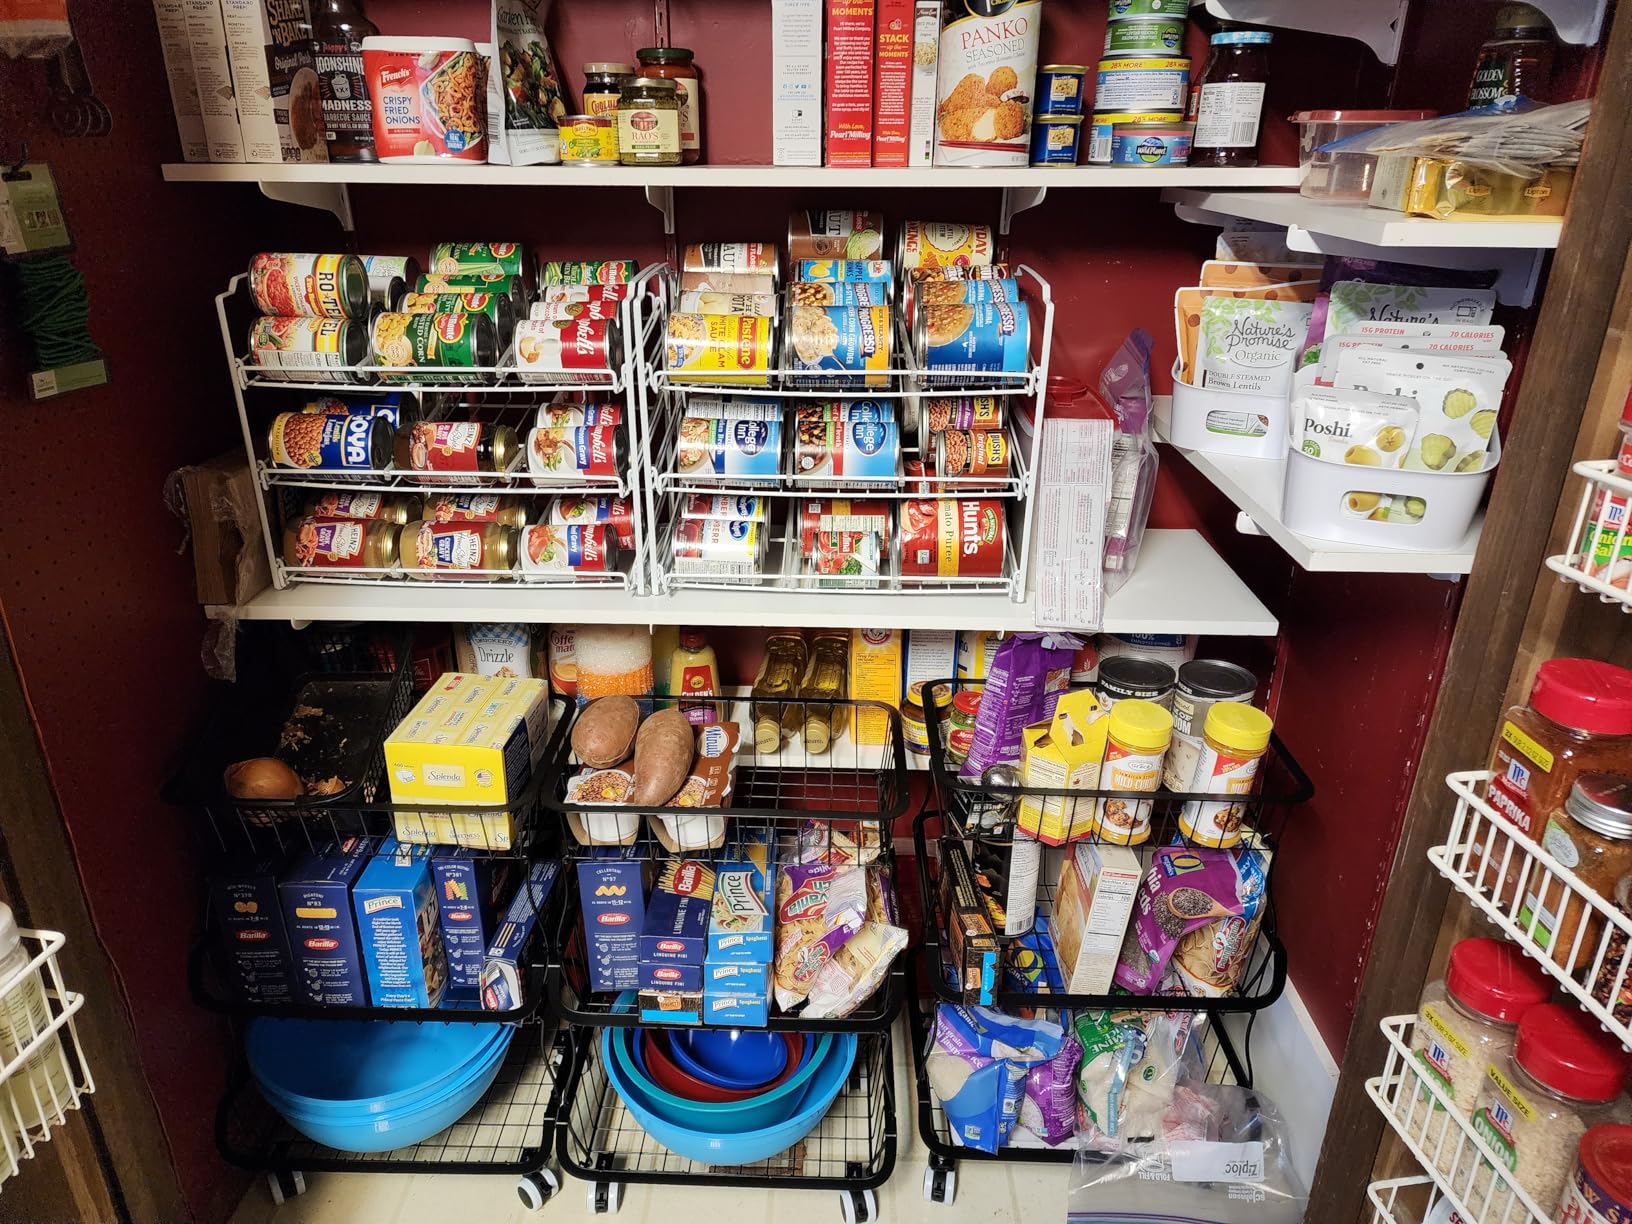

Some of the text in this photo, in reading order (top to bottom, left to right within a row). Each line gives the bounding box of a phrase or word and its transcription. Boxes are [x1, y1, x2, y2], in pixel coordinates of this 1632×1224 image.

[268, 0, 305, 26] SHAKE
[831, 7, 874, 16] MOMENTS
[879, 34, 909, 43] STACK
[960, 17, 1028, 50] PANKO
[965, 38, 1025, 63] SEASONED
[381, 67, 410, 83] French's
[1476, 69, 1504, 82] GOLDEN
[321, 100, 372, 111] MADNESS
[383, 96, 412, 105] CRISPY
[351, 113, 372, 121] SAUCE
[384, 106, 409, 115] FRIED
[385, 116, 421, 125] ONIONS
[632, 131, 659, 140] RAO'S
[857, 306, 875, 354] PROGRESSO
[1230, 316, 1296, 339] Nature's
[1374, 327, 1405, 336] PROTEIN
[1460, 331, 1495, 340] CALORIES
[709, 320, 719, 353] SAUCE
[740, 316, 756, 366] Pastene
[1225, 334, 1297, 353] Promise
[416, 336, 427, 364] CORN
[717, 340, 727, 368] CLAM
[1235, 350, 1281, 362] Organic
[1439, 343, 1475, 352] CALORIES
[1208, 370, 1271, 382] DOUBLE STEAMED
[1208, 377, 1261, 391] Brown Lentils
[331, 420, 344, 443] Lentils
[737, 423, 747, 440] Inn
[855, 423, 866, 439] Inn
[1304, 417, 1352, 439] Poshi
[577, 445, 587, 466] Gravy
[975, 432, 988, 466] Original
[989, 432, 1003, 463] BUSH'S
[348, 526, 360, 552] HEINZ
[943, 530, 953, 563] Puree
[437, 538, 446, 560] GRAVY
[444, 536, 453, 562] CHICKEN
[467, 536, 478, 563] HEINZ
[478, 646, 515, 663] Drizzle
[1100, 680, 1159, 698] FAMILY SIZE
[705, 726, 722, 758] Minute
[428, 770, 461, 782] Splenda
[1115, 775, 1133, 789] MILD
[1488, 783, 1531, 832] PAPRIKA
[402, 825, 436, 838] Splenda
[677, 864, 697, 893] Barilla
[1146, 865, 1162, 894] hia
[727, 874, 755, 913] Prince
[367, 898, 401, 911] Prince
[600, 915, 627, 923] Barilla
[672, 907, 688, 935] LINGUINE
[308, 940, 337, 948] Barilla
[659, 942, 683, 951] Barilla
[719, 937, 742, 947] Prince
[656, 970, 680, 979] Barilla
[714, 967, 737, 977] Prince
[713, 1000, 736, 1010] Prince
[1489, 1068, 1531, 1118] VALUE SIZE
[1224, 1159, 1258, 1177] Ziploc
